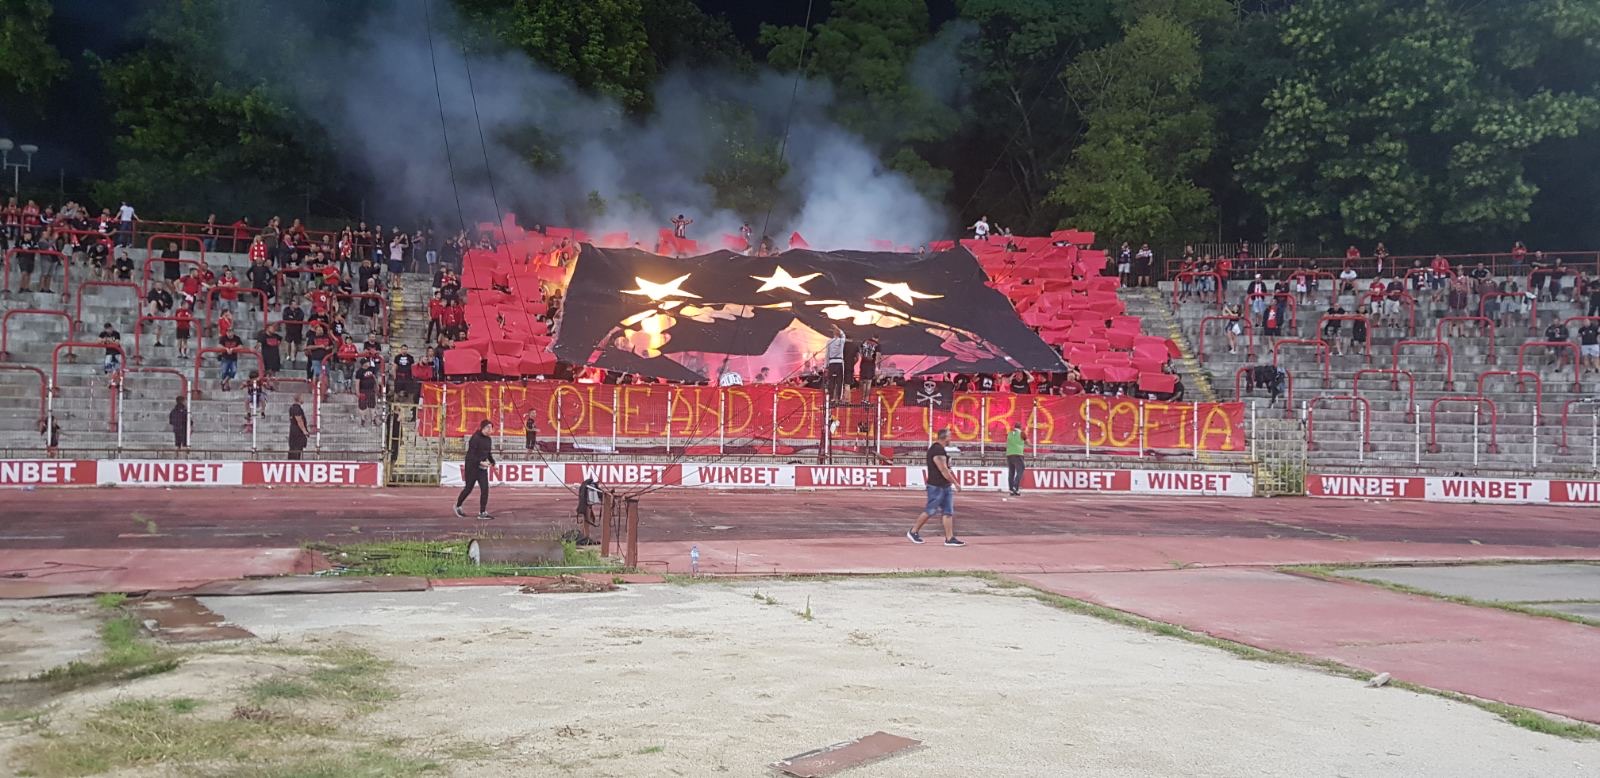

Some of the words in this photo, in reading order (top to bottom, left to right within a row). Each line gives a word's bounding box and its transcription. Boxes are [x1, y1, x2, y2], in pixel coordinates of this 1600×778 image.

[422, 384, 527, 435] THE
[548, 386, 652, 436] ONE
[661, 386, 754, 436] AND
[1077, 398, 1234, 451] SOFIA
[118, 463, 223, 482] WINBET
[261, 463, 360, 483] WINBET
[459, 464, 548, 482] NBET
[581, 465, 665, 484] WINBET
[698, 466, 780, 484] WINBET
[810, 467, 892, 485] WINBET
[1033, 470, 1116, 489] WINBET
[1147, 472, 1231, 491] WINBET
[1321, 477, 1409, 496] WINBET
[1442, 480, 1532, 499] WINBET
